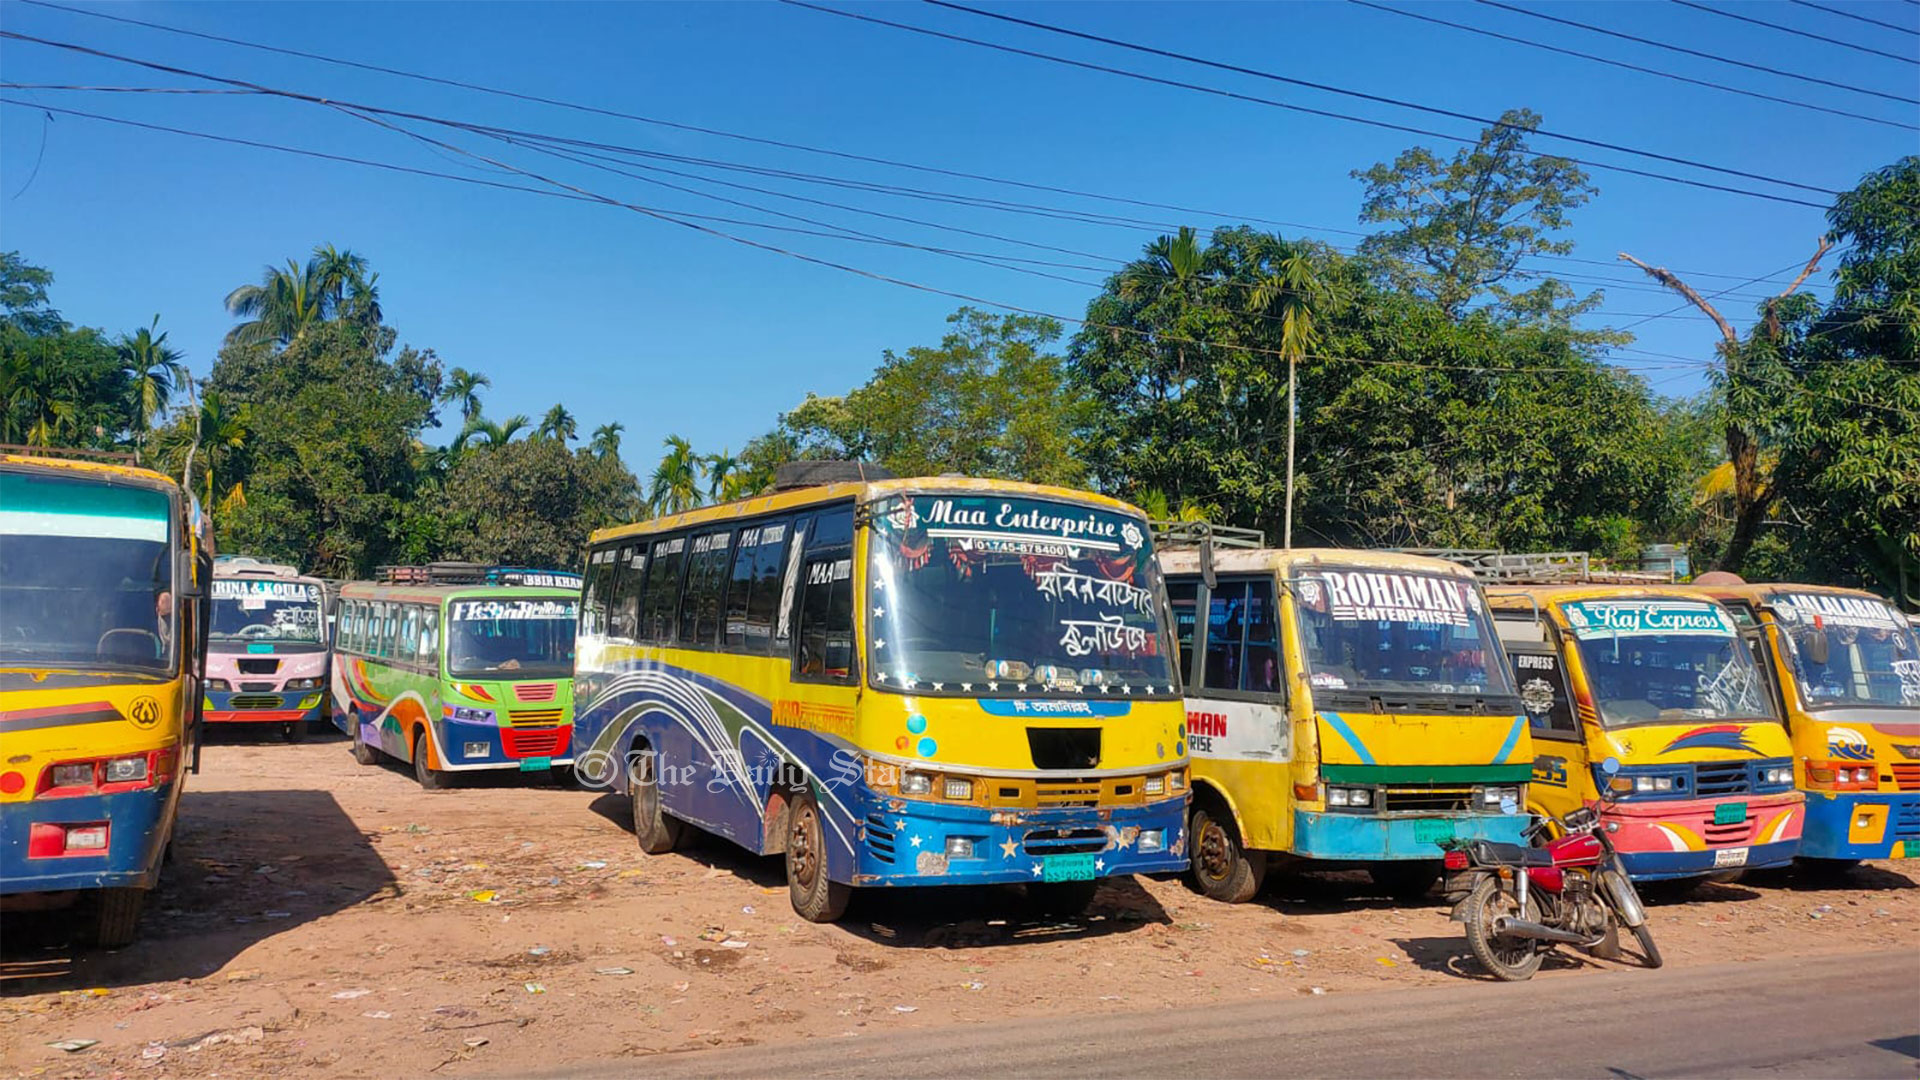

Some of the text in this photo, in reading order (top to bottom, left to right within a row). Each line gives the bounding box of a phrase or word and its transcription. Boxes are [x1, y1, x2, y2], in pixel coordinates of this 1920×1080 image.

[922, 500, 1118, 538] Maa Enterprise
[1322, 572, 1467, 613] ROHAMAN
[1356, 607, 1453, 625] ENTERPRISE
[1595, 604, 1720, 636] Raj Express
[1518, 655, 1554, 670] EXPRESS
[1187, 735, 1213, 752] RISE
